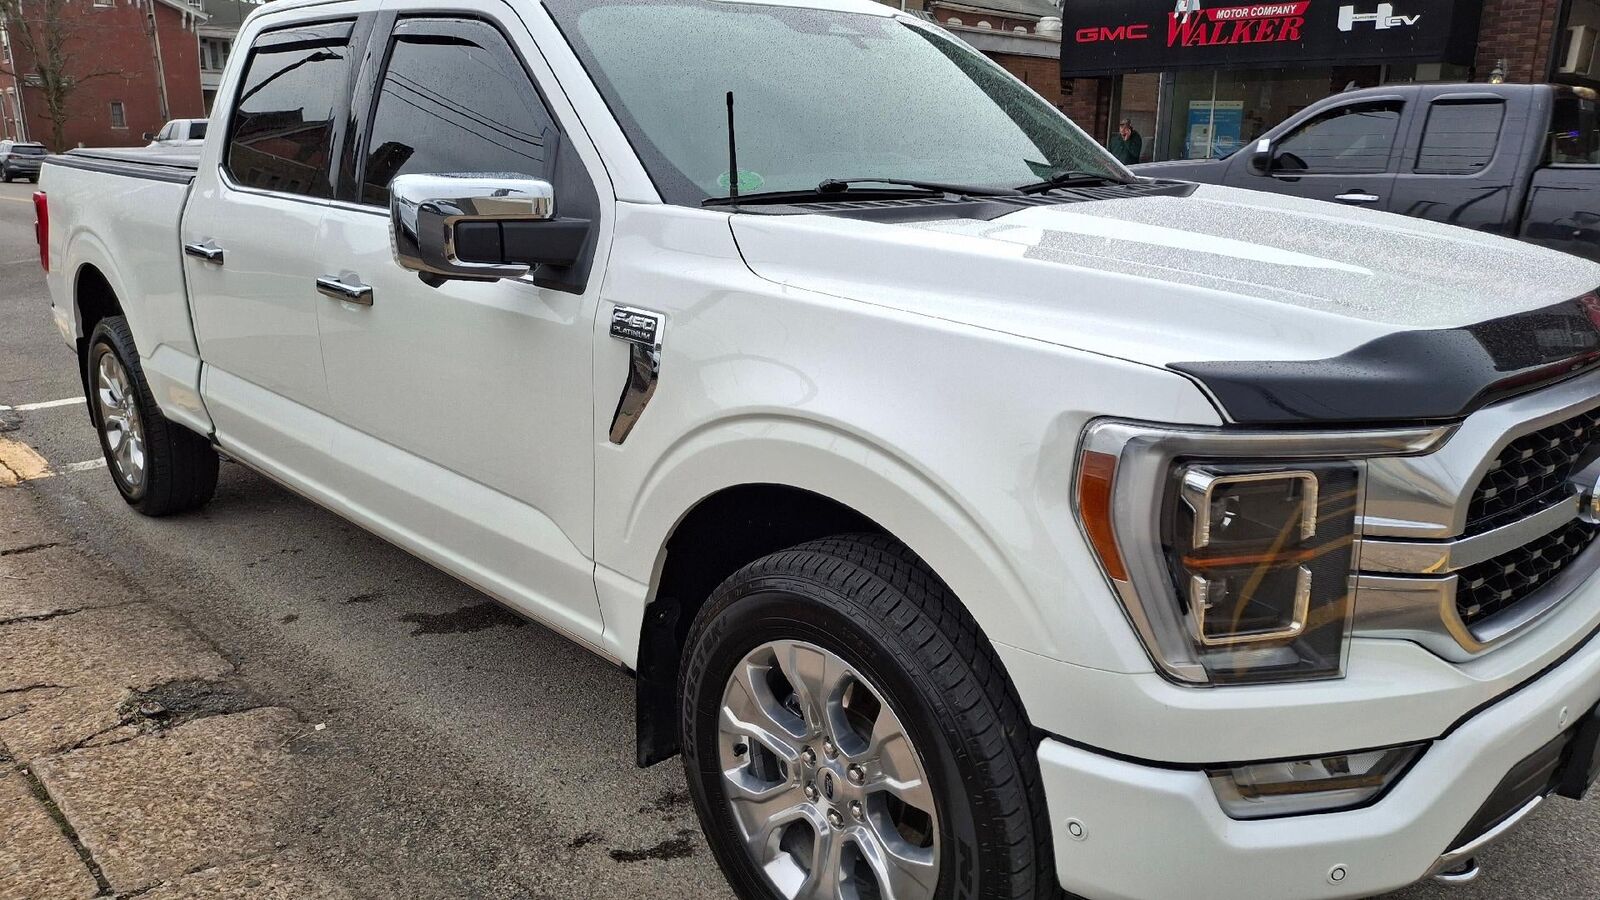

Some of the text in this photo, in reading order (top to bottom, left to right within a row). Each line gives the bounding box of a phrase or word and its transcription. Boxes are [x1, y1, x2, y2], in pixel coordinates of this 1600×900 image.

[1216, 4, 1297, 19] MOTOR COMPANY
[1075, 24, 1148, 43] GMC
[1167, 9, 1305, 47] WALKER
